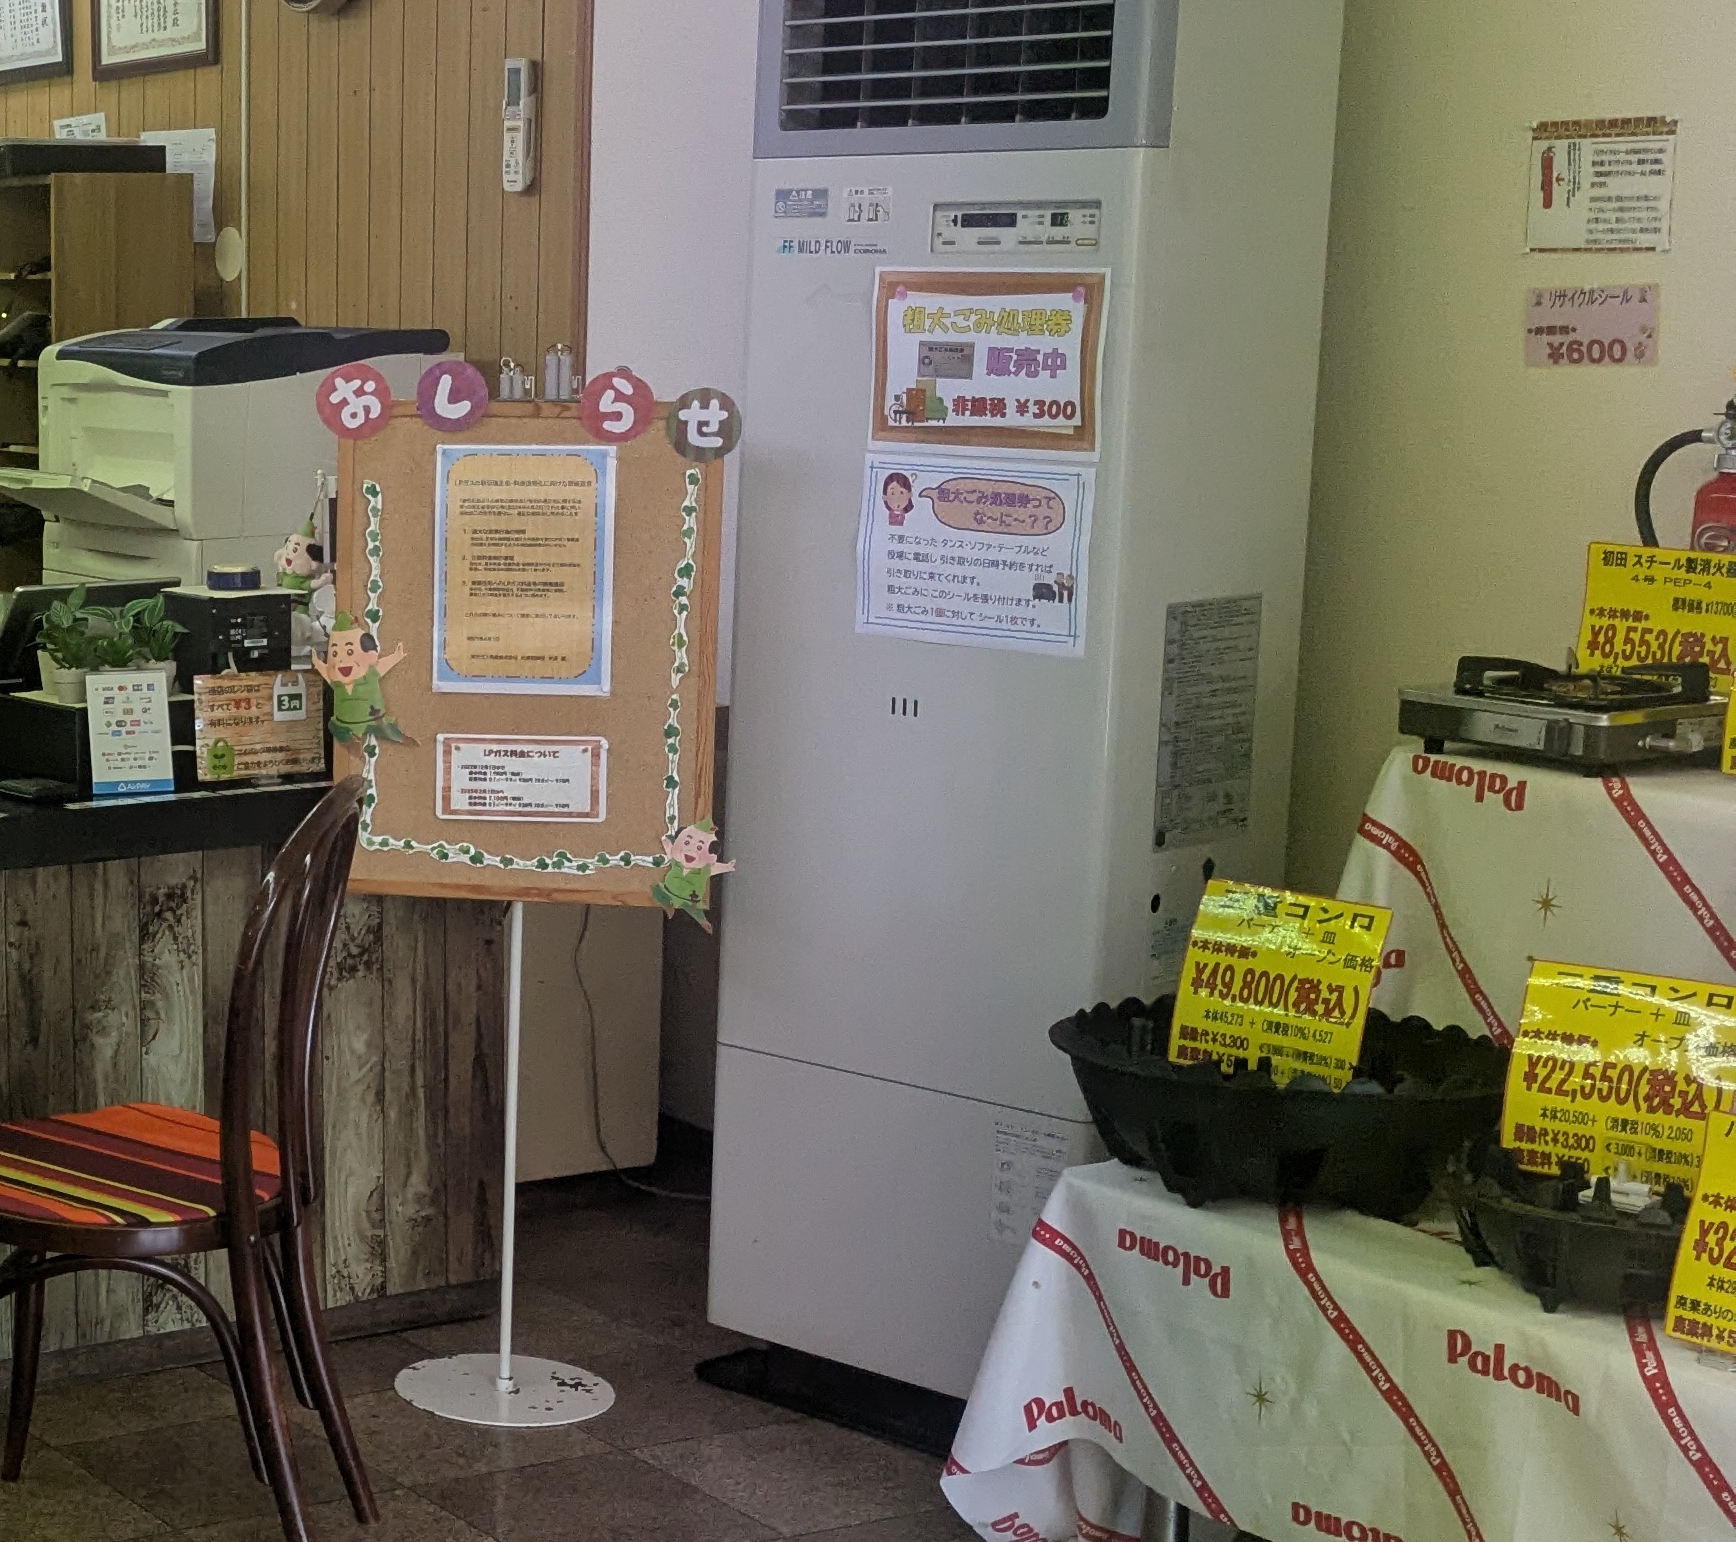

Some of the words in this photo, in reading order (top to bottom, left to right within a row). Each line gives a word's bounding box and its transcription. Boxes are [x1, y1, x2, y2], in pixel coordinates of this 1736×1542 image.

[781, 239, 794, 254] FF
[797, 239, 821, 255] MILD
[824, 239, 851, 255] FLOW
[1548, 288, 1633, 308] リサイクルシール
[902, 305, 1072, 337] 粗大ごみ処理券
[985, 346, 1068, 379] 販売中
[1547, 339, 1628, 364] ¥600
[328, 374, 729, 448] おしらせ
[951, 395, 1008, 419] 非課税
[1014, 399, 1078, 421] ¥300
[937, 487, 1057, 510] 粗大ごみ処理券って
[888, 533, 938, 548] 不要になった
[940, 538, 1050, 557] タンス・ソファ・テーブルなど
[939, 554, 1054, 574] 引き取りの日時予約をすれば
[1601, 549, 1628, 568] 初田
[886, 567, 981, 587] 引き取りに来てくれます。
[1630, 574, 1657, 585] 4号
[1663, 576, 1713, 590] PEP-4
[887, 584, 929, 598] 粗大ごみに
[896, 603, 976, 621] 粗大ごみ1個に対して
[978, 612, 1042, 628] シール1枚です。
[279, 696, 301, 710] 3円
[483, 749, 560, 759] LPガス料金について
[1411, 753, 1529, 812] Paloma
[1198, 939, 1253, 960] 本体特価
[1556, 970, 1734, 1011] 二重コンロ
[1572, 996, 1643, 1019] バーナー
[1522, 1053, 1723, 1121] ¥22,550(税込)
[1605, 1115, 1665, 1139] (消費税10%)
[1117, 1228, 1232, 1299] Paloma
[1446, 1328, 1581, 1417] Paloma
[1023, 1386, 1124, 1444] Paloma
[1667, 1406, 1703, 1463] Paloma
